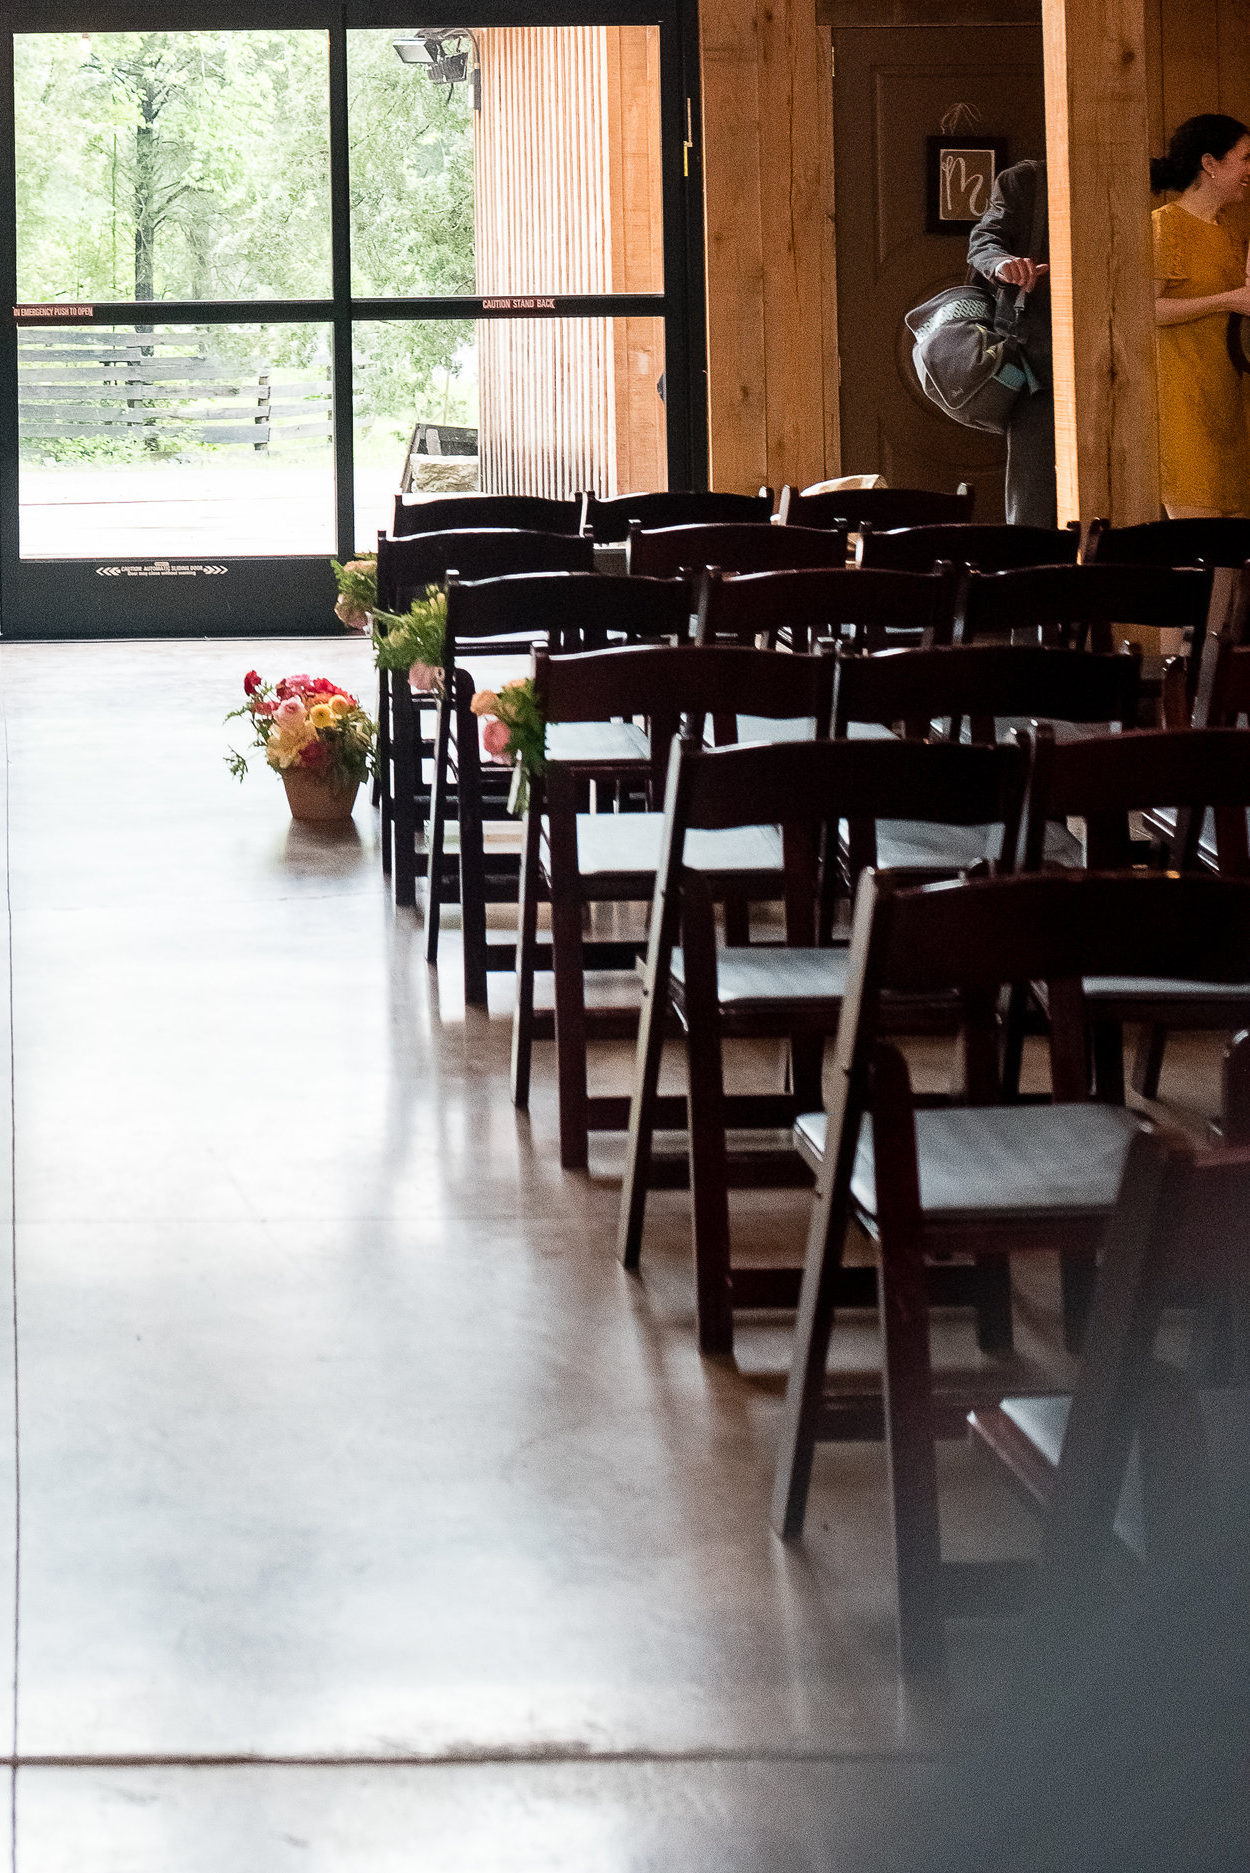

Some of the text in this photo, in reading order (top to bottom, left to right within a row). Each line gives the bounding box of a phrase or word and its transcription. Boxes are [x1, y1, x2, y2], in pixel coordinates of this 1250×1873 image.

[482, 299, 555, 308] CAUTION STAND BACK
[21, 308, 53, 317] EMERGENCY
[54, 308, 70, 317] PUSH
[70, 308, 77, 316] TO
[78, 308, 93, 316] OPEN
